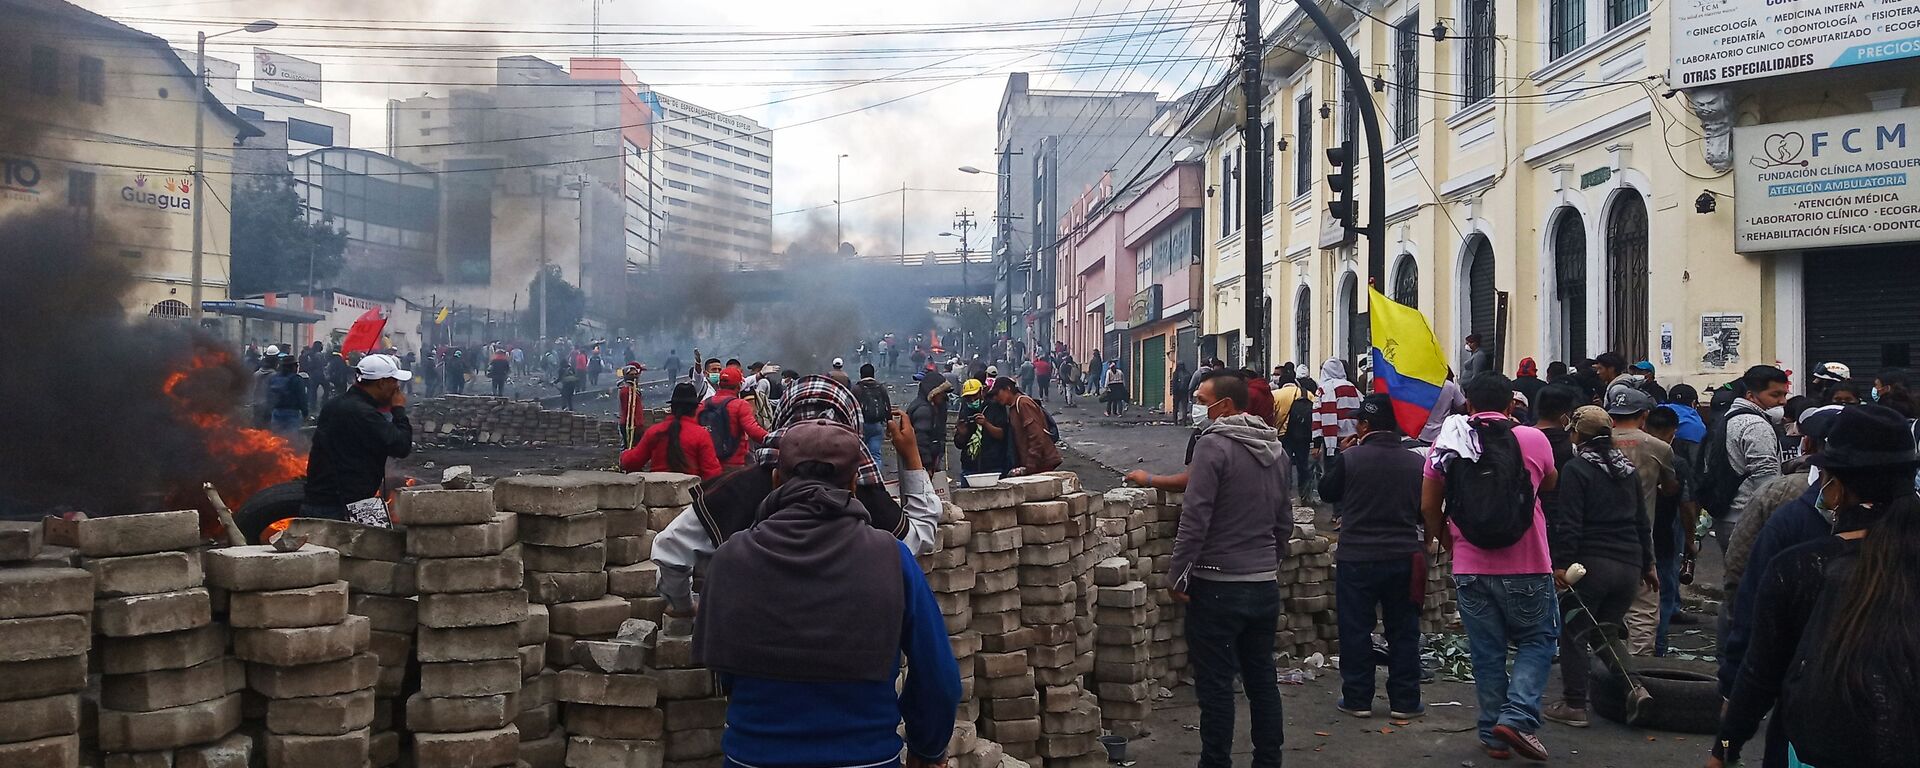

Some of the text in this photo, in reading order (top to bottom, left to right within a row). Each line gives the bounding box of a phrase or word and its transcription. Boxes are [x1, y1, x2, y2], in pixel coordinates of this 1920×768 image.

[1773, 1, 1865, 22] MEDICINA INTERNA
[1692, 17, 1757, 36] GINECOLOGÍA
[1784, 14, 1858, 35] ODONTOLOGÍA
[1682, 27, 1872, 65] LABORATORIO CLINICO COMPUTARIZADO
[1721, 30, 1766, 45] PEDIATRÍA
[1683, 53, 1814, 84] OTRAS ESPECIALIDADES
[1758, 167, 1818, 182] FUNDACIÓN
[1820, 163, 1862, 176] CLÍNICA
[1769, 175, 1905, 196] ATENCIÓN AMBULATORIA
[121, 186, 191, 210] Guagua
[1798, 193, 1899, 209] ATENCIÓN MÉDICA
[1751, 211, 1824, 226] LABORATORIO
[1826, 207, 1869, 220] CLÍNICO
[1746, 225, 1830, 242] REHABILITACIÓN
[1833, 224, 1866, 235] FÍSICA
